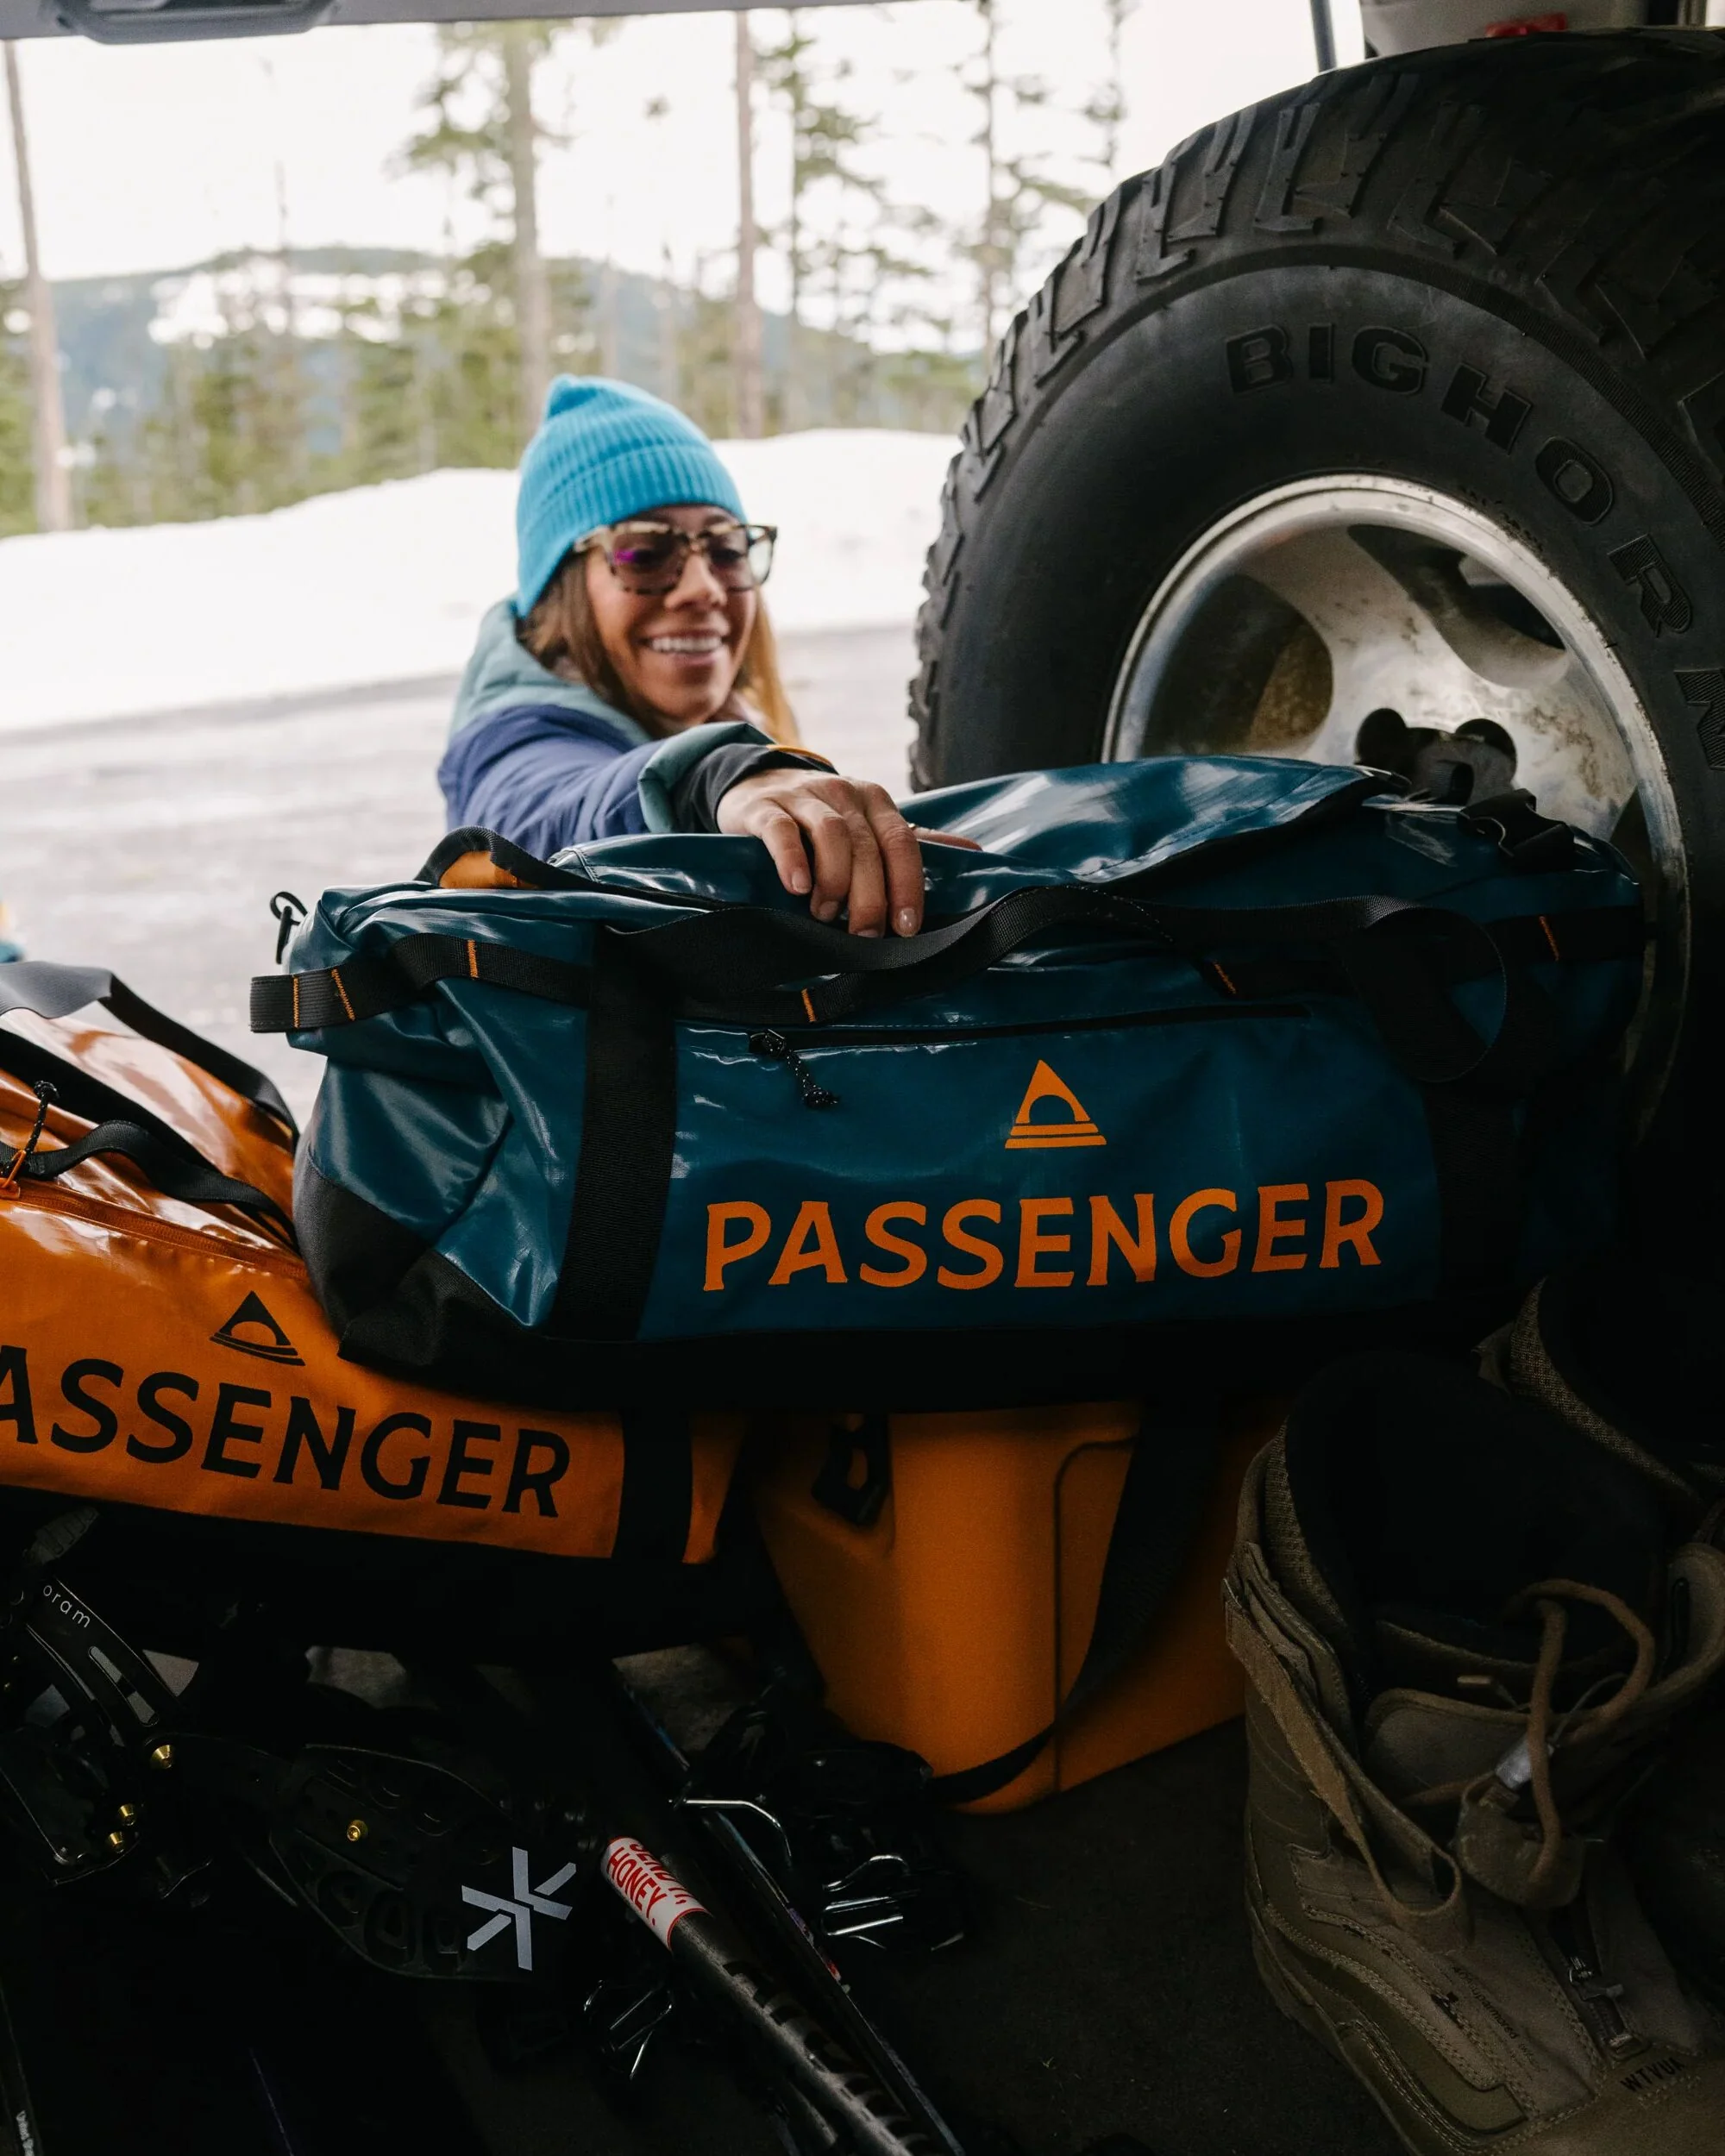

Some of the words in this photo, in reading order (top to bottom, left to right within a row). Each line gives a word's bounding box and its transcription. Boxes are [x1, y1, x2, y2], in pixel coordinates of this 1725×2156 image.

[1226, 322, 1725, 772] BIGHORN
[702, 1178, 1385, 1293] PASSENGER
[0, 1344, 570, 1518] ASSENGER
